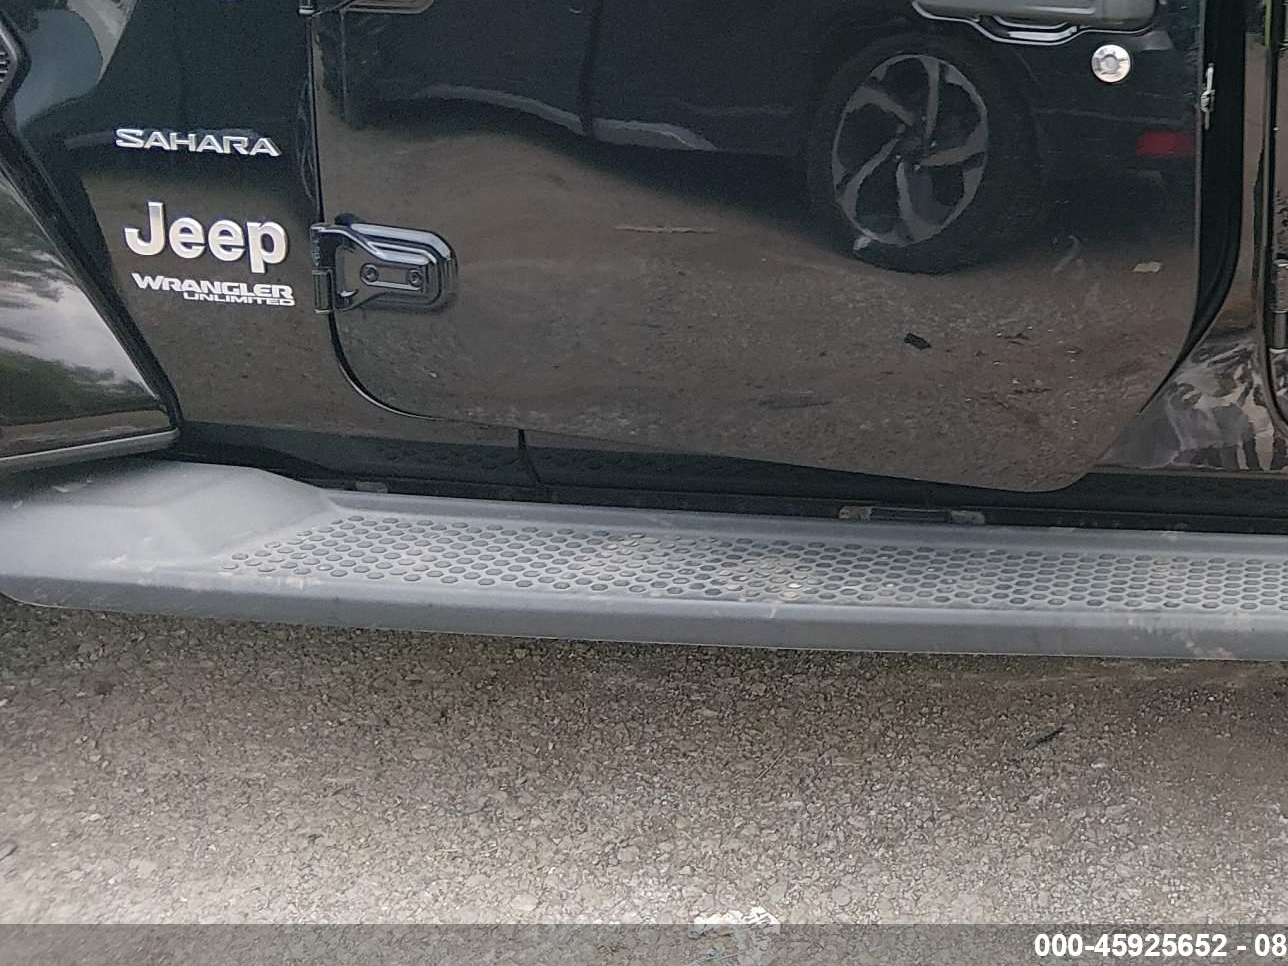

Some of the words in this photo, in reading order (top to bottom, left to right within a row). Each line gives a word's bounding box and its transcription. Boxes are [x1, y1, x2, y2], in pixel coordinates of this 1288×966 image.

[115, 128, 282, 157] SAHARA
[124, 201, 288, 274] Jeep
[131, 272, 294, 300] WRANGLER
[183, 291, 296, 307] UNLIMITED
